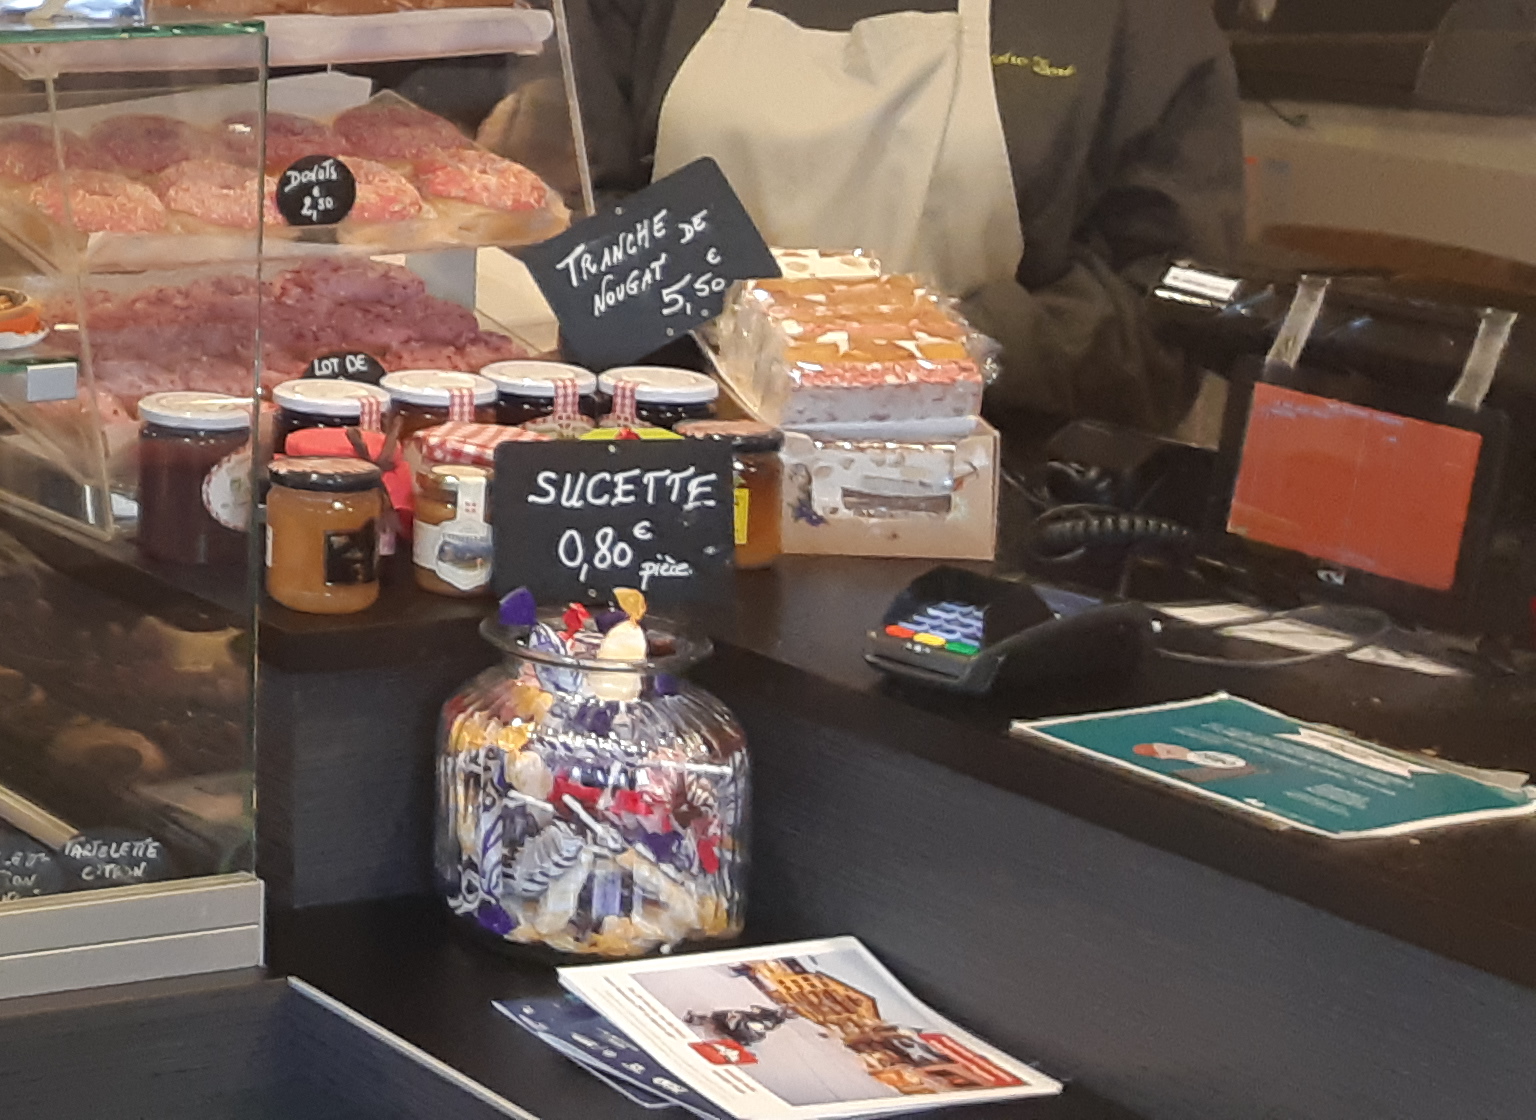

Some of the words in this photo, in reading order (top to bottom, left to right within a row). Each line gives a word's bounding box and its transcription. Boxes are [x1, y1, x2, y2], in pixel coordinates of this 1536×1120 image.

[555, 208, 668, 288] TRANCHE
[676, 209, 708, 244] DE
[593, 252, 668, 317] NOUGAT
[313, 357, 339, 377] LOT
[345, 353, 368, 373] DE
[528, 466, 718, 511] SUCETTE
